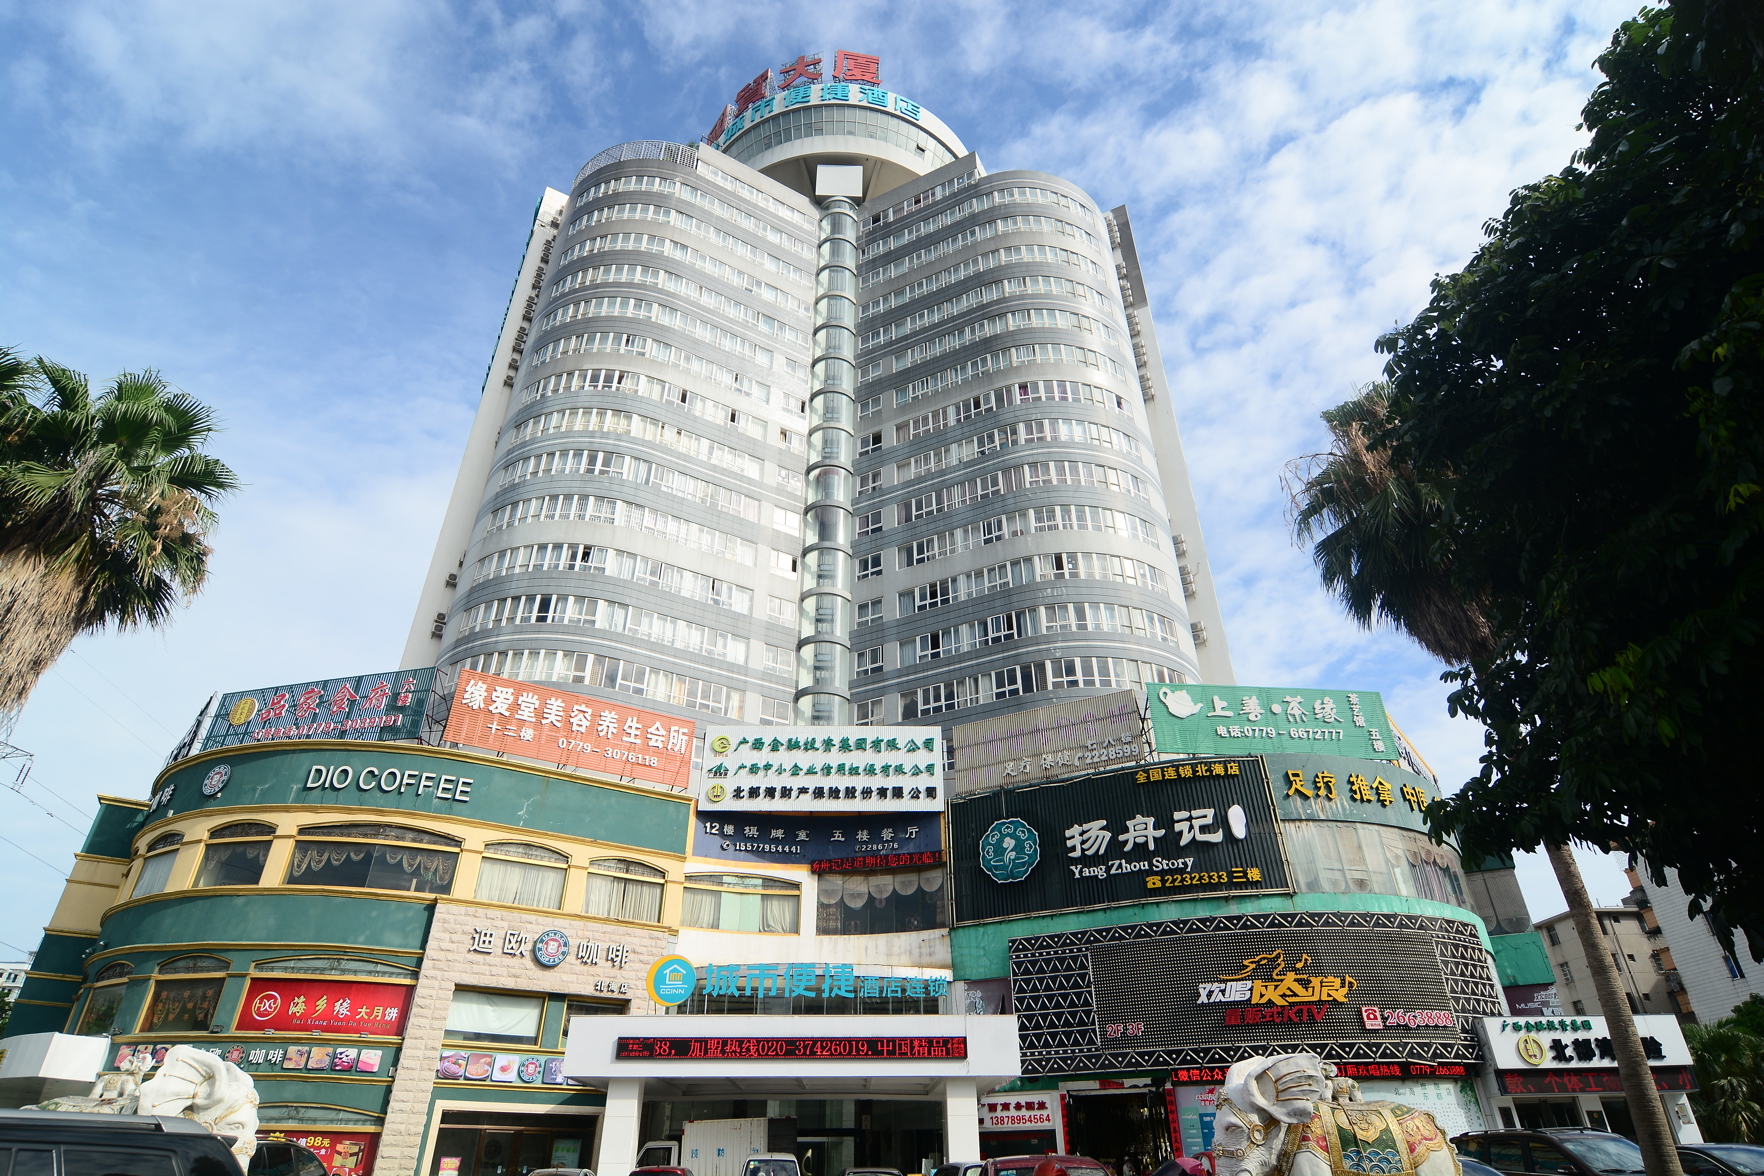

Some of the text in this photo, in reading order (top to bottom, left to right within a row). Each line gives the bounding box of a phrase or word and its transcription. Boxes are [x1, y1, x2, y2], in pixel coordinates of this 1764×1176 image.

[723, 83, 921, 146] 城市便捷酒店
[258, 681, 392, 722] 品家食府
[397, 678, 416, 707] 六楼
[461, 679, 689, 755] 缘爱堂美容养生会所
[1347, 693, 1366, 727] 茶艺馆
[486, 721, 535, 742] 十二楼
[1368, 729, 1386, 752] 五楼
[733, 736, 937, 753] 广西金融投资集团有限公司
[1084, 744, 1140, 764] 2228599
[733, 761, 937, 777] 广西中小企业信用担保有限公司
[1135, 763, 1241, 784] 全国连锁北海店
[306, 765, 475, 803] DIO COFFEE
[733, 785, 938, 799] 北部湾财产保险股份有限公司
[1286, 769, 1337, 800] 足疗
[1349, 773, 1395, 807] 推拿
[744, 826, 810, 842] 棋牌室
[830, 826, 920, 841] 五楼餐厅
[1064, 808, 1223, 858] 扬舟记
[1070, 856, 1194, 879] Yang Zhou Story
[1165, 867, 1263, 887] 2232333 三楼
[470, 927, 630, 968] 迪欧 咖啡
[595, 980, 630, 994] 北海店
[702, 963, 949, 999] 城市便捷 酒店连锁
[288, 995, 399, 1022] 海乡缘 大月饼
[1222, 1004, 1330, 1027] 量贩式KTV
[1384, 1009, 1454, 1028] 2663888
[1106, 1021, 1145, 1039] 2F 3F
[1502, 1019, 1594, 1033] 广西金融投资集团
[248, 1048, 285, 1064] 咖啡
[1549, 1036, 1667, 1063] 北部湾险
[1409, 1065, 1466, 1076] 0779-2663888
[989, 1113, 1051, 1126] 13878954564
[290, 1136, 331, 1148] 值98元
